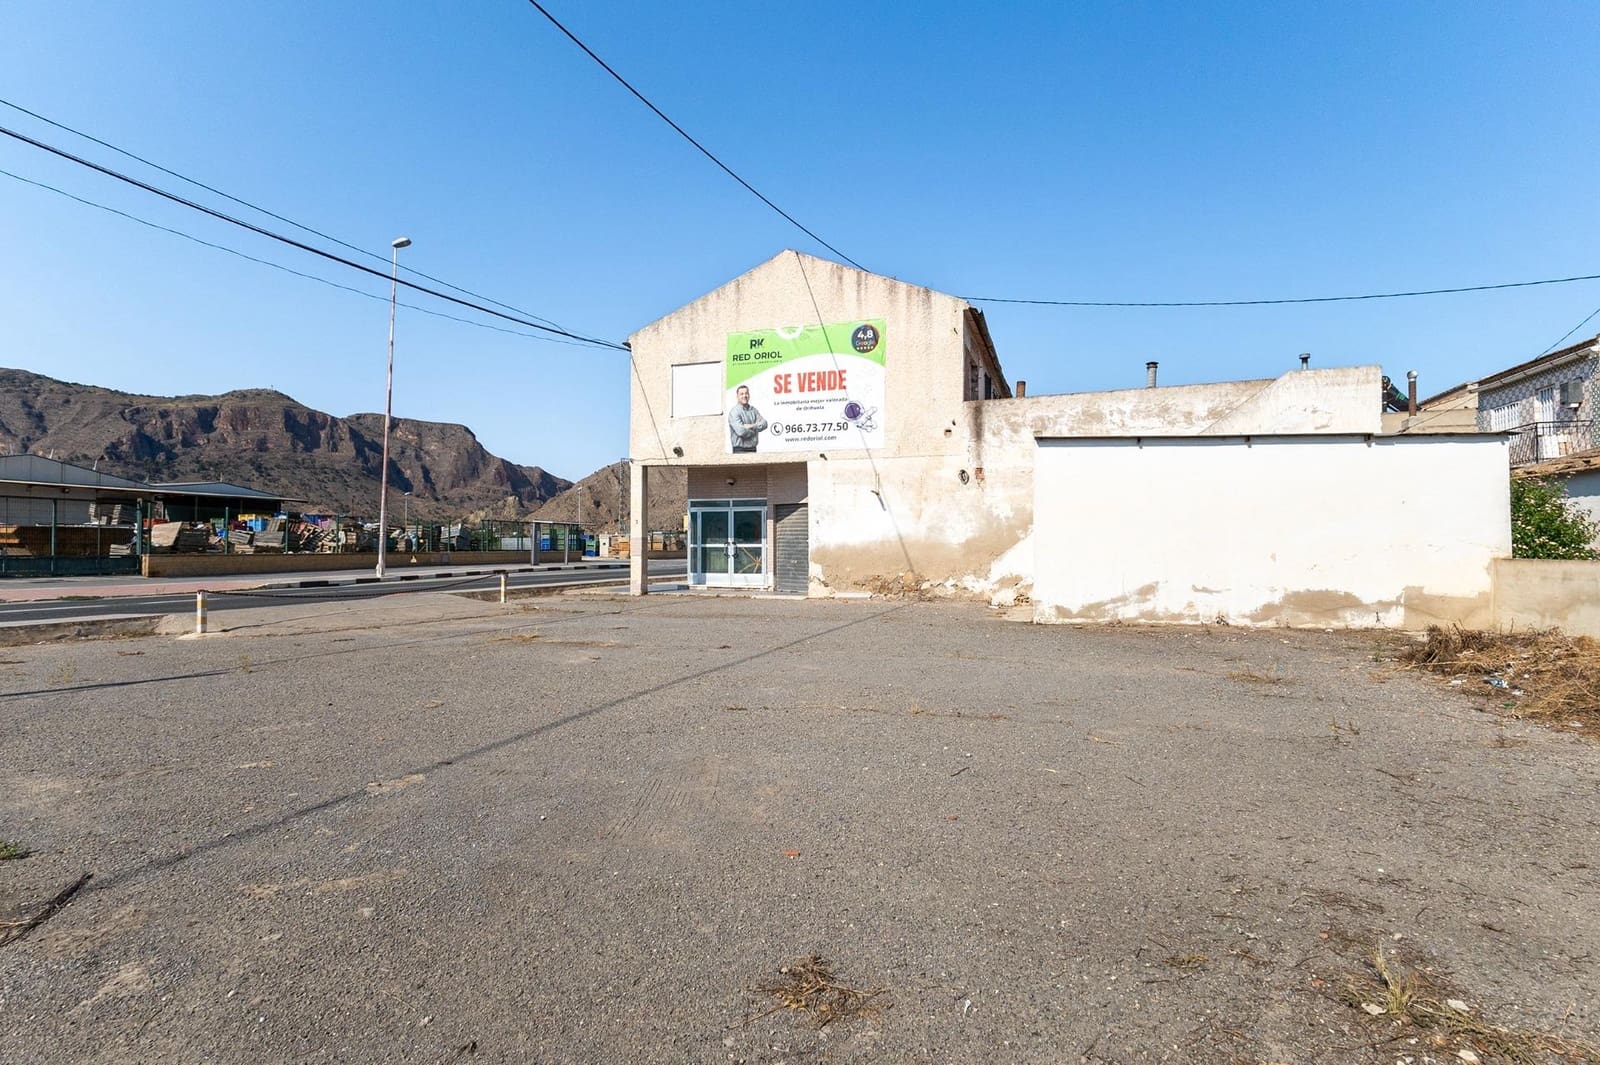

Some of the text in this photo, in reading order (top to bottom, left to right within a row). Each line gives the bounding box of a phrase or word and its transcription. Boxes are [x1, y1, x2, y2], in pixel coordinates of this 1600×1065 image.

[857, 329, 874, 340] 4,8
[732, 351, 783, 362] RED ORIOL
[773, 369, 847, 394] SE VENDE
[785, 421, 849, 434] 966.73.77.50
